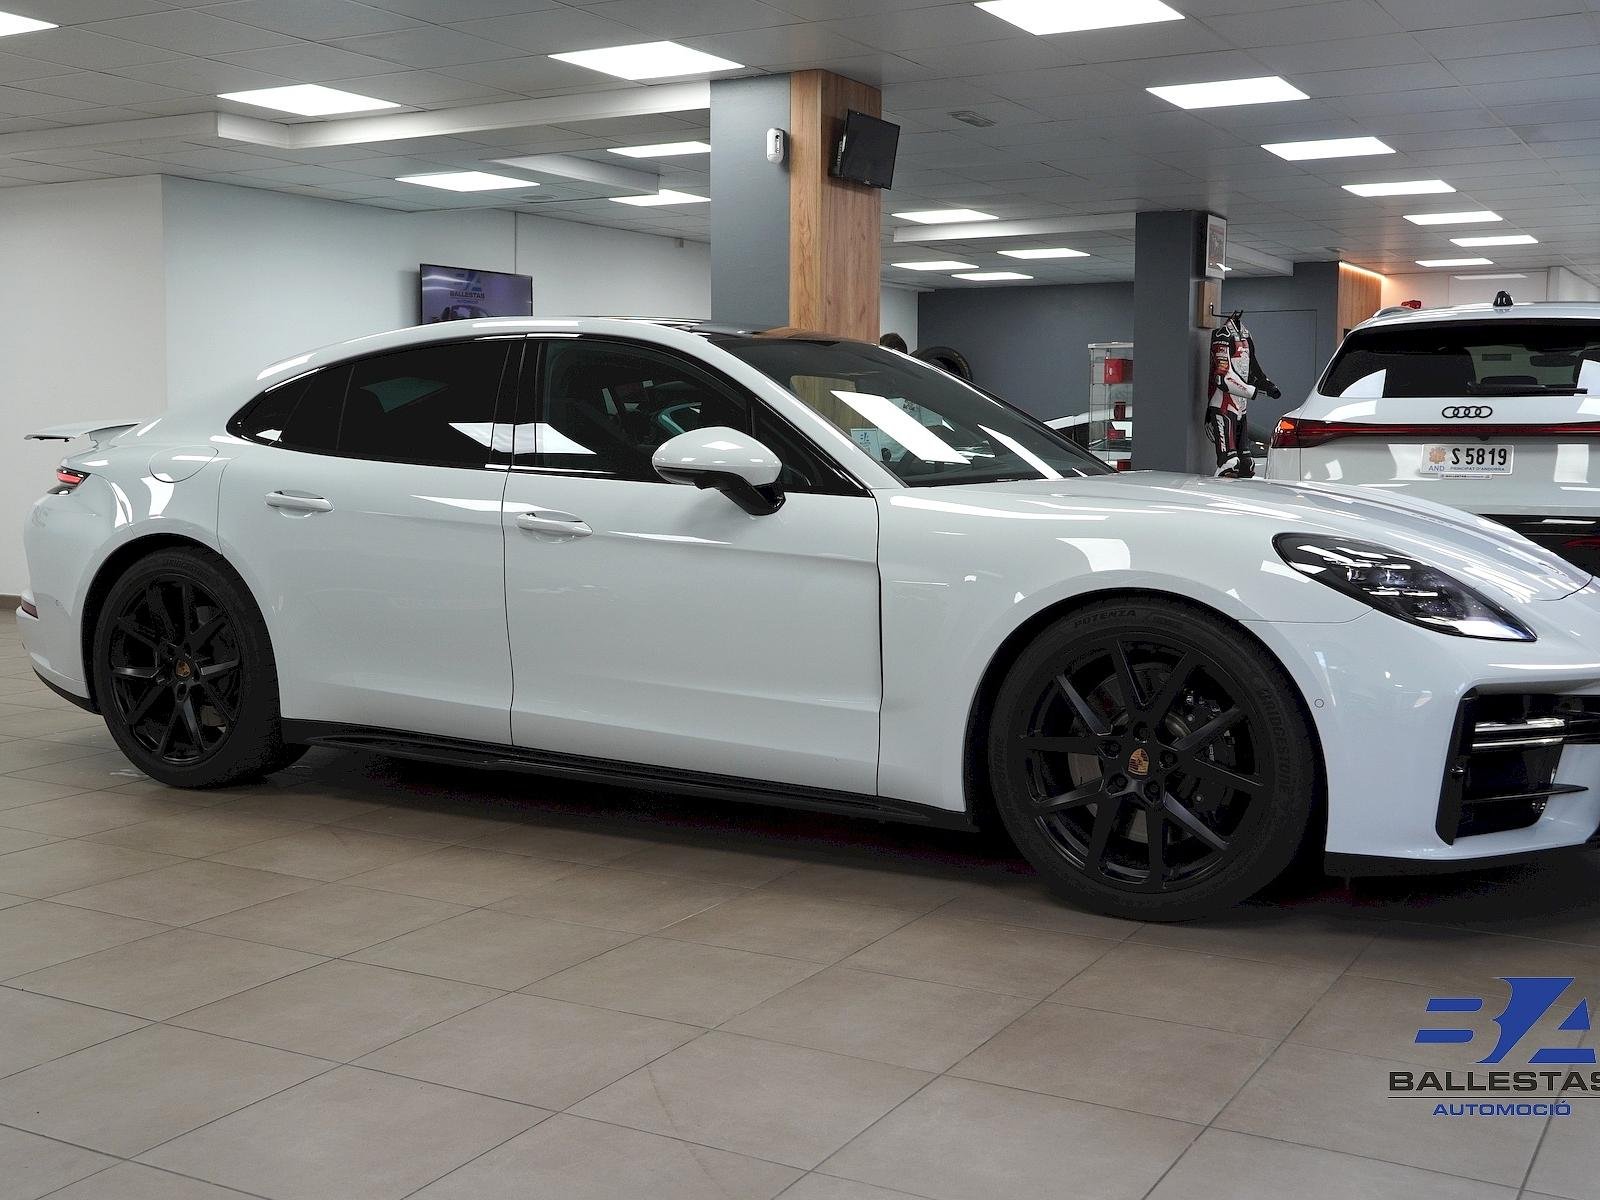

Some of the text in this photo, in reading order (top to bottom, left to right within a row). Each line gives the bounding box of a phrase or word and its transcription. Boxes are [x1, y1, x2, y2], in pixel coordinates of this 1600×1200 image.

[1451, 448, 1508, 466] S 5819
[1428, 464, 1445, 472] AND
